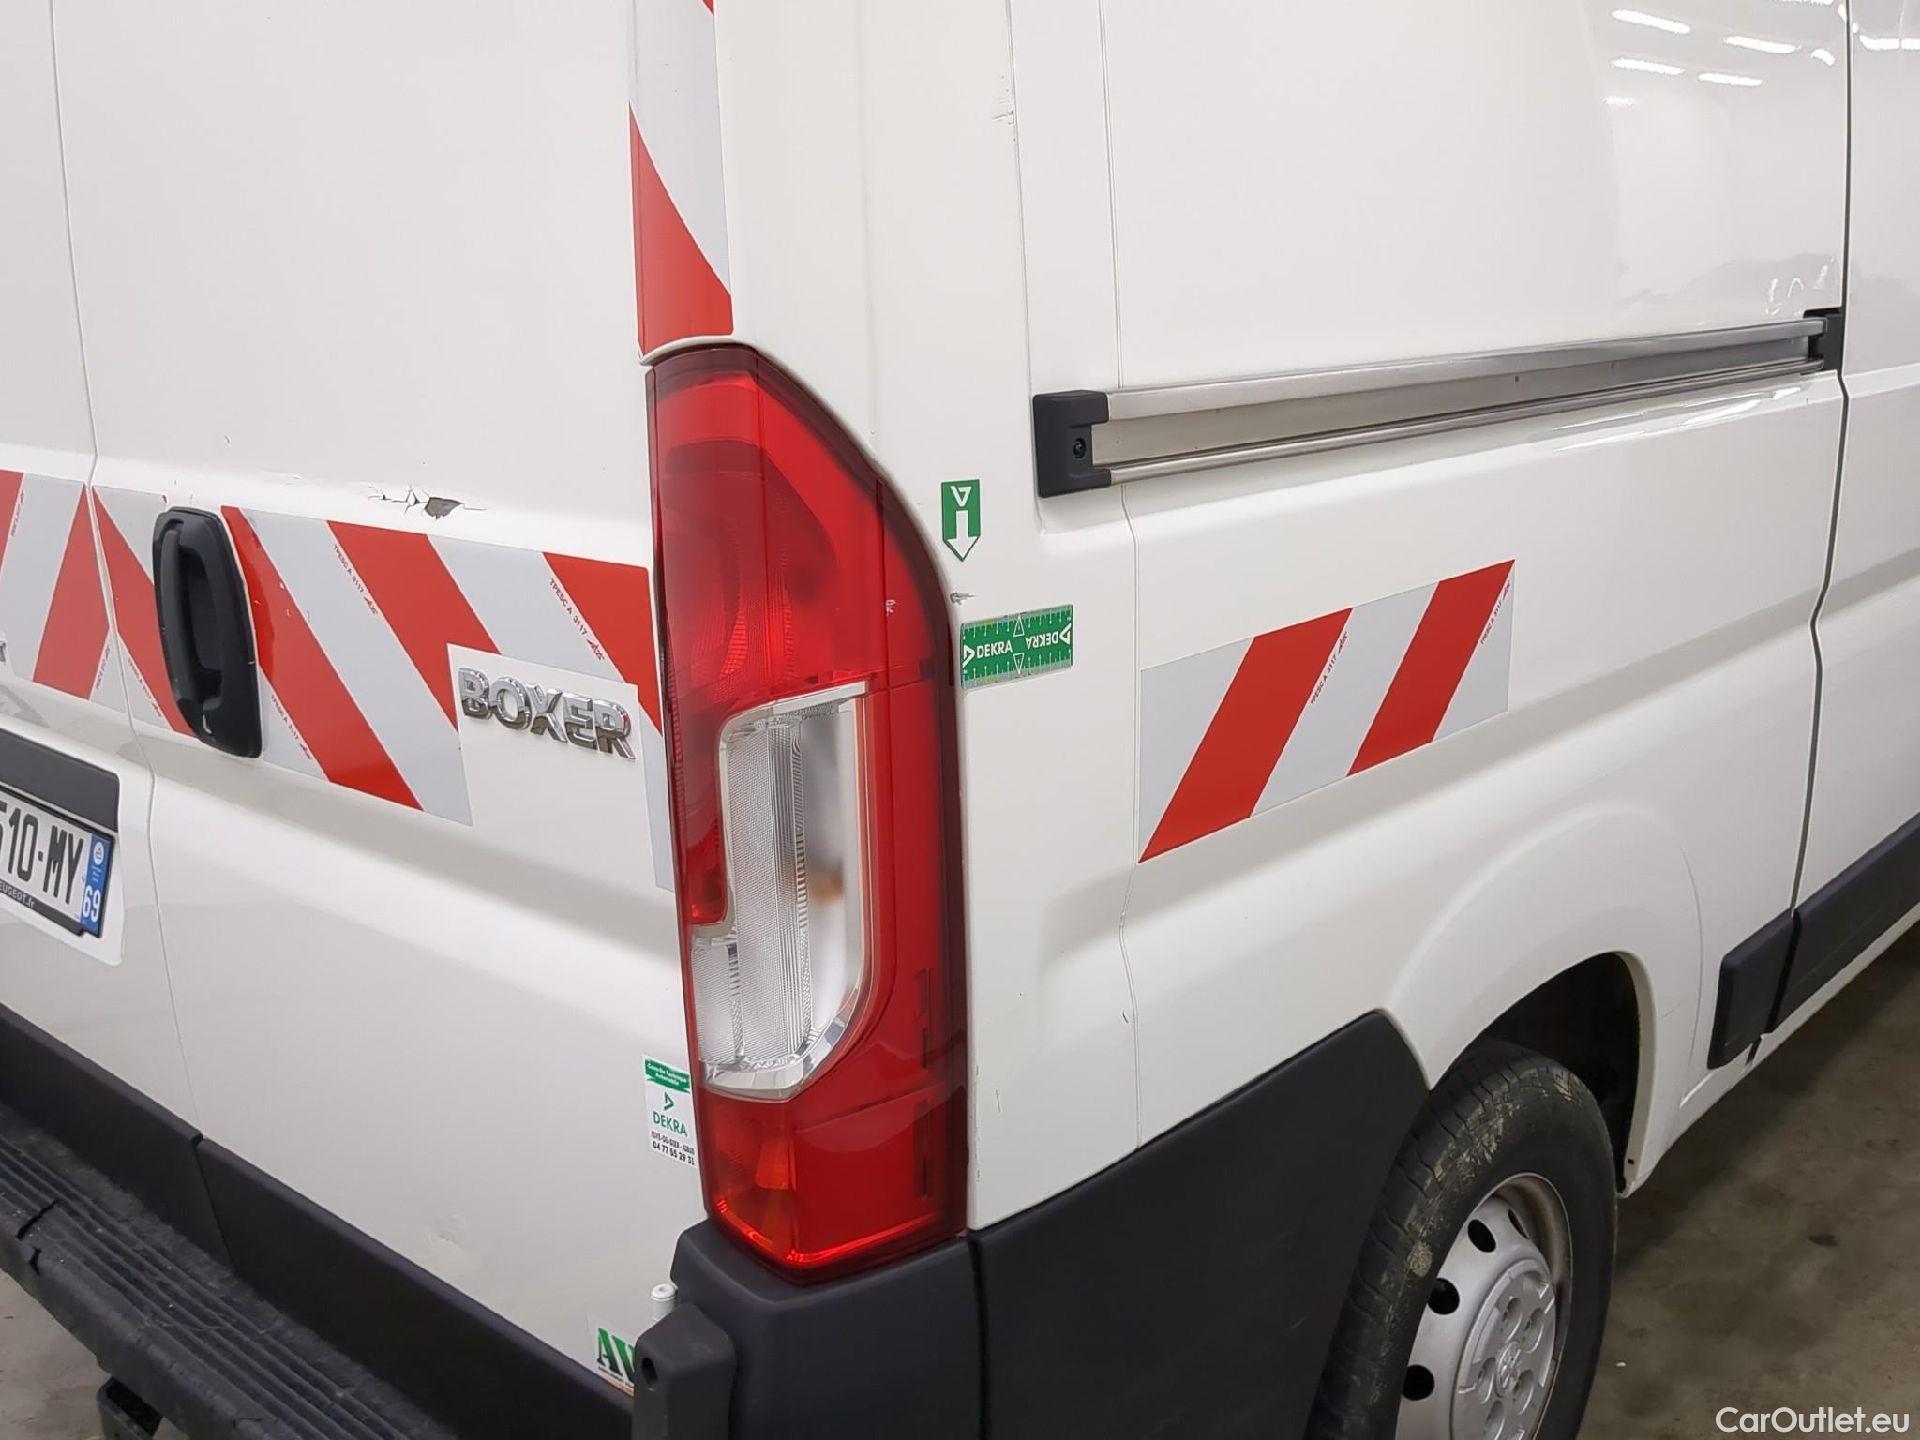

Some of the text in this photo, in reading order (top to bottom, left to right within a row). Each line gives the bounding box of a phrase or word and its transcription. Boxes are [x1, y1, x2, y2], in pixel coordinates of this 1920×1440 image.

[976, 639, 1014, 659] DEKRA
[1025, 631, 1059, 650] DEKRA
[457, 667, 637, 760] BOXER
[82, 885, 102, 923] 69
[652, 1109, 688, 1138] DEKRA
